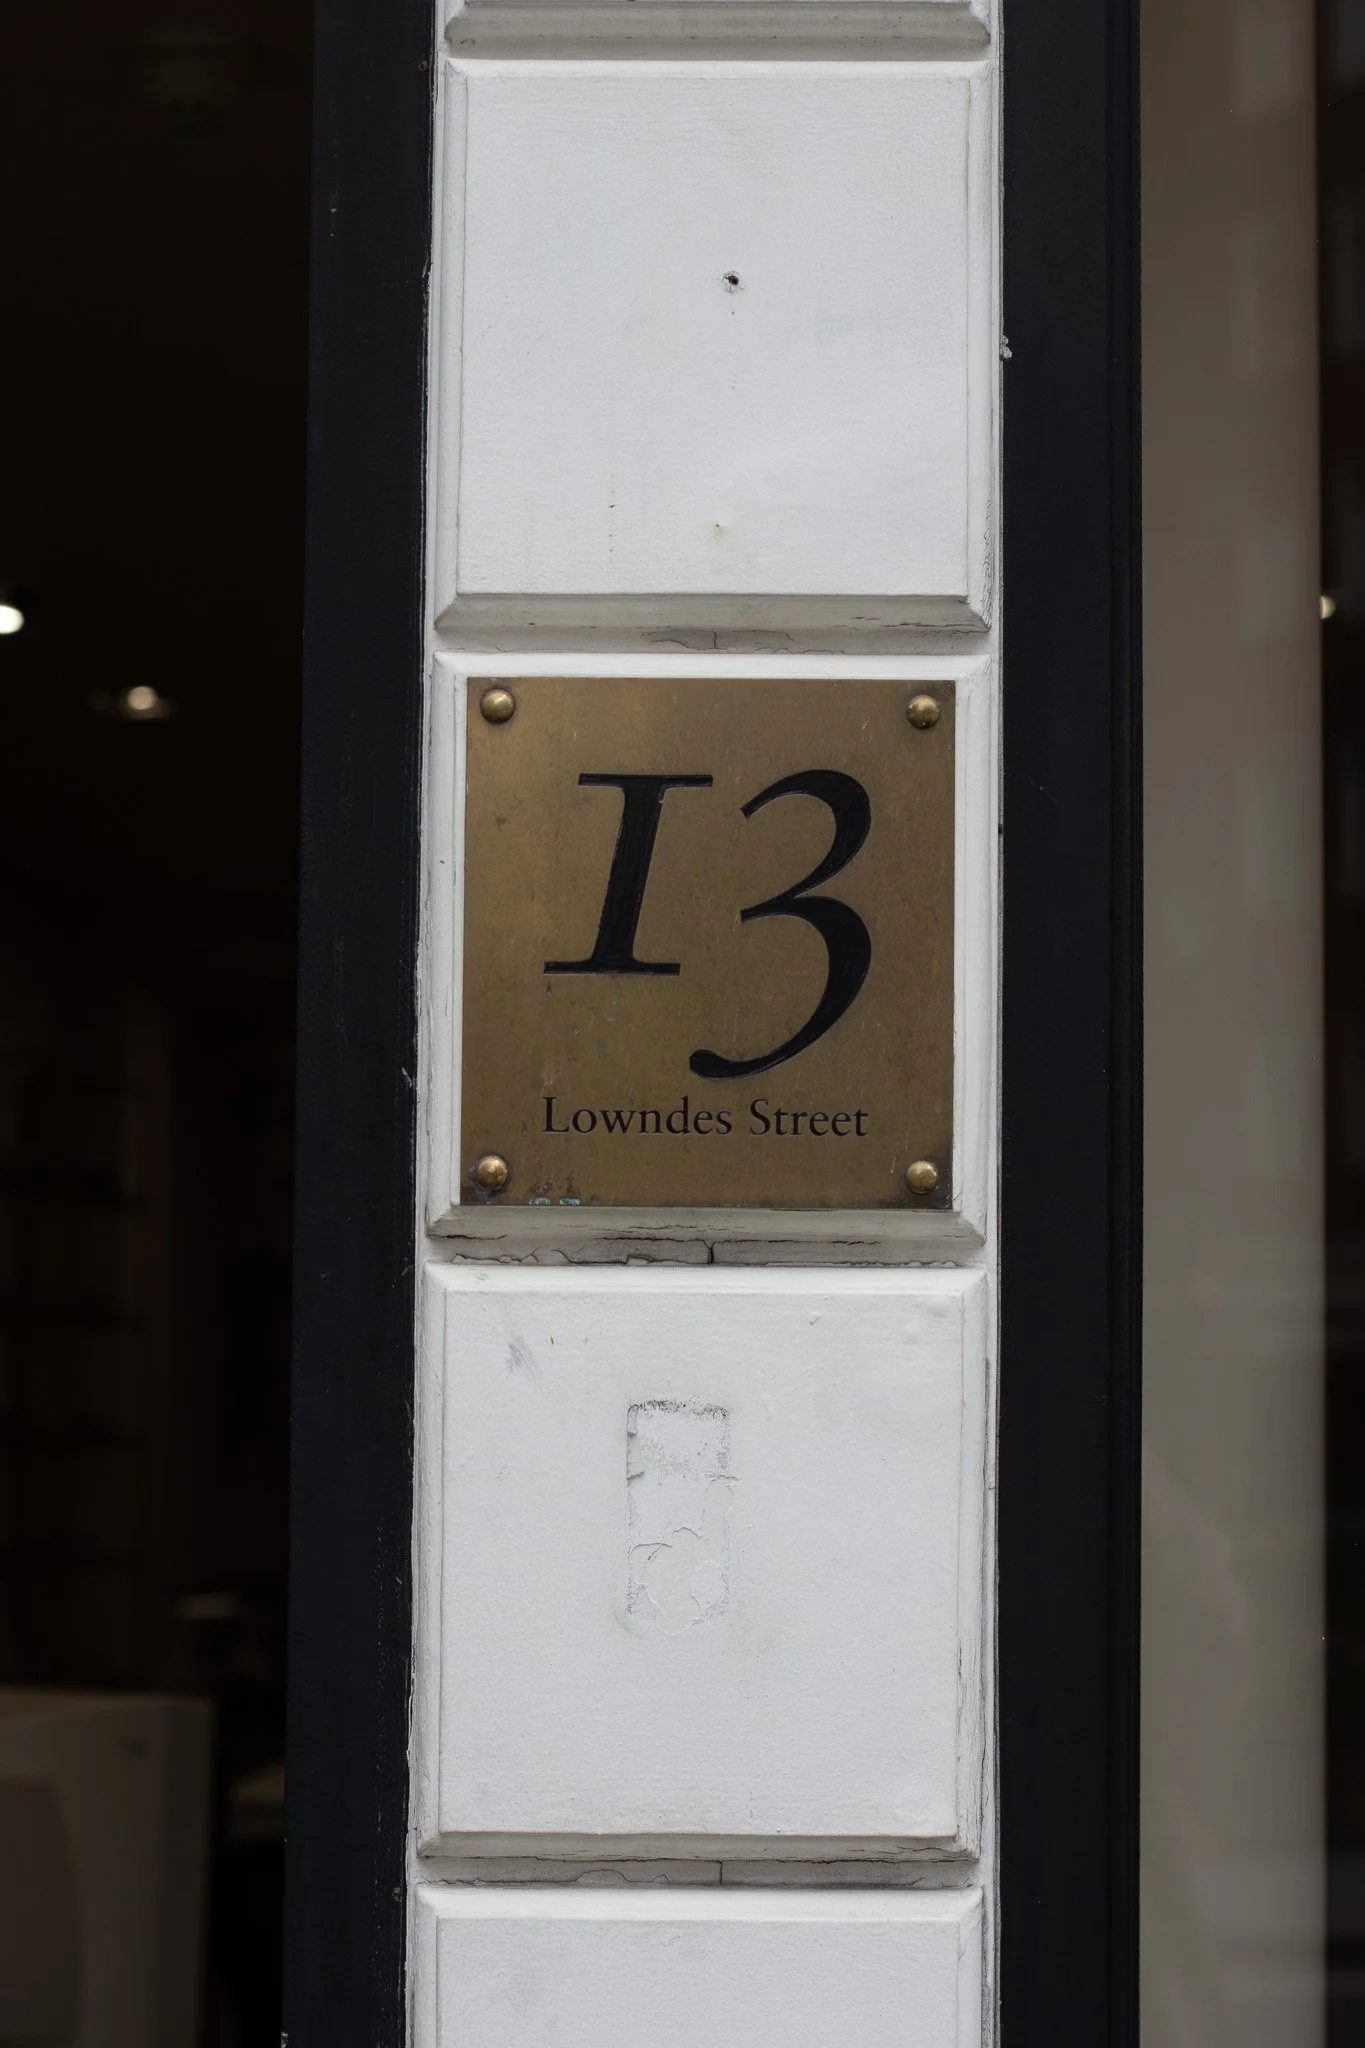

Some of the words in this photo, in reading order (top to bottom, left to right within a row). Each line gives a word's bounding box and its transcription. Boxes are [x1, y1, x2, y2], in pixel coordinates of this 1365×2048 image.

[543, 769, 872, 1083] 13
[541, 1095, 733, 1136] Lowndes
[748, 1098, 869, 1137] Street
